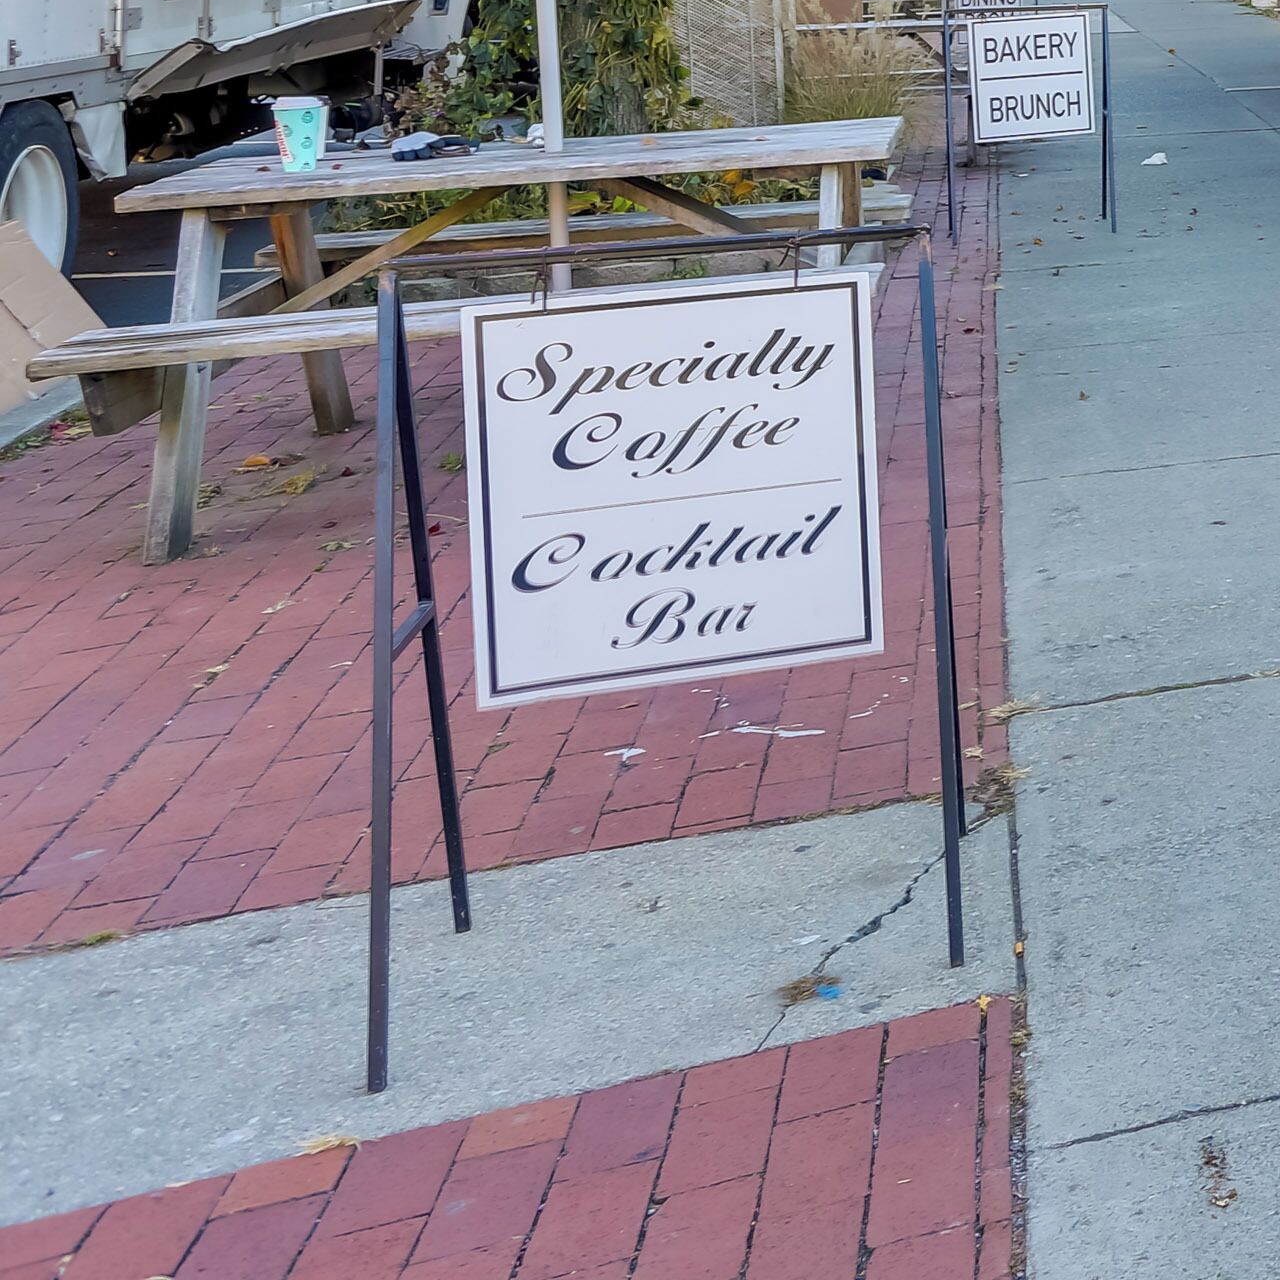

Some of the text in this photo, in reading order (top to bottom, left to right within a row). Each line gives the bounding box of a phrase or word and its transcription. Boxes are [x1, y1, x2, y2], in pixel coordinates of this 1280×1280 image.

[983, 31, 1078, 64] BAKERY
[989, 90, 1081, 123] BRUNCH
[495, 328, 836, 416] Specialty
[551, 403, 801, 479] Coffee
[511, 504, 842, 594] Cocktail
[610, 587, 758, 650] Bar
